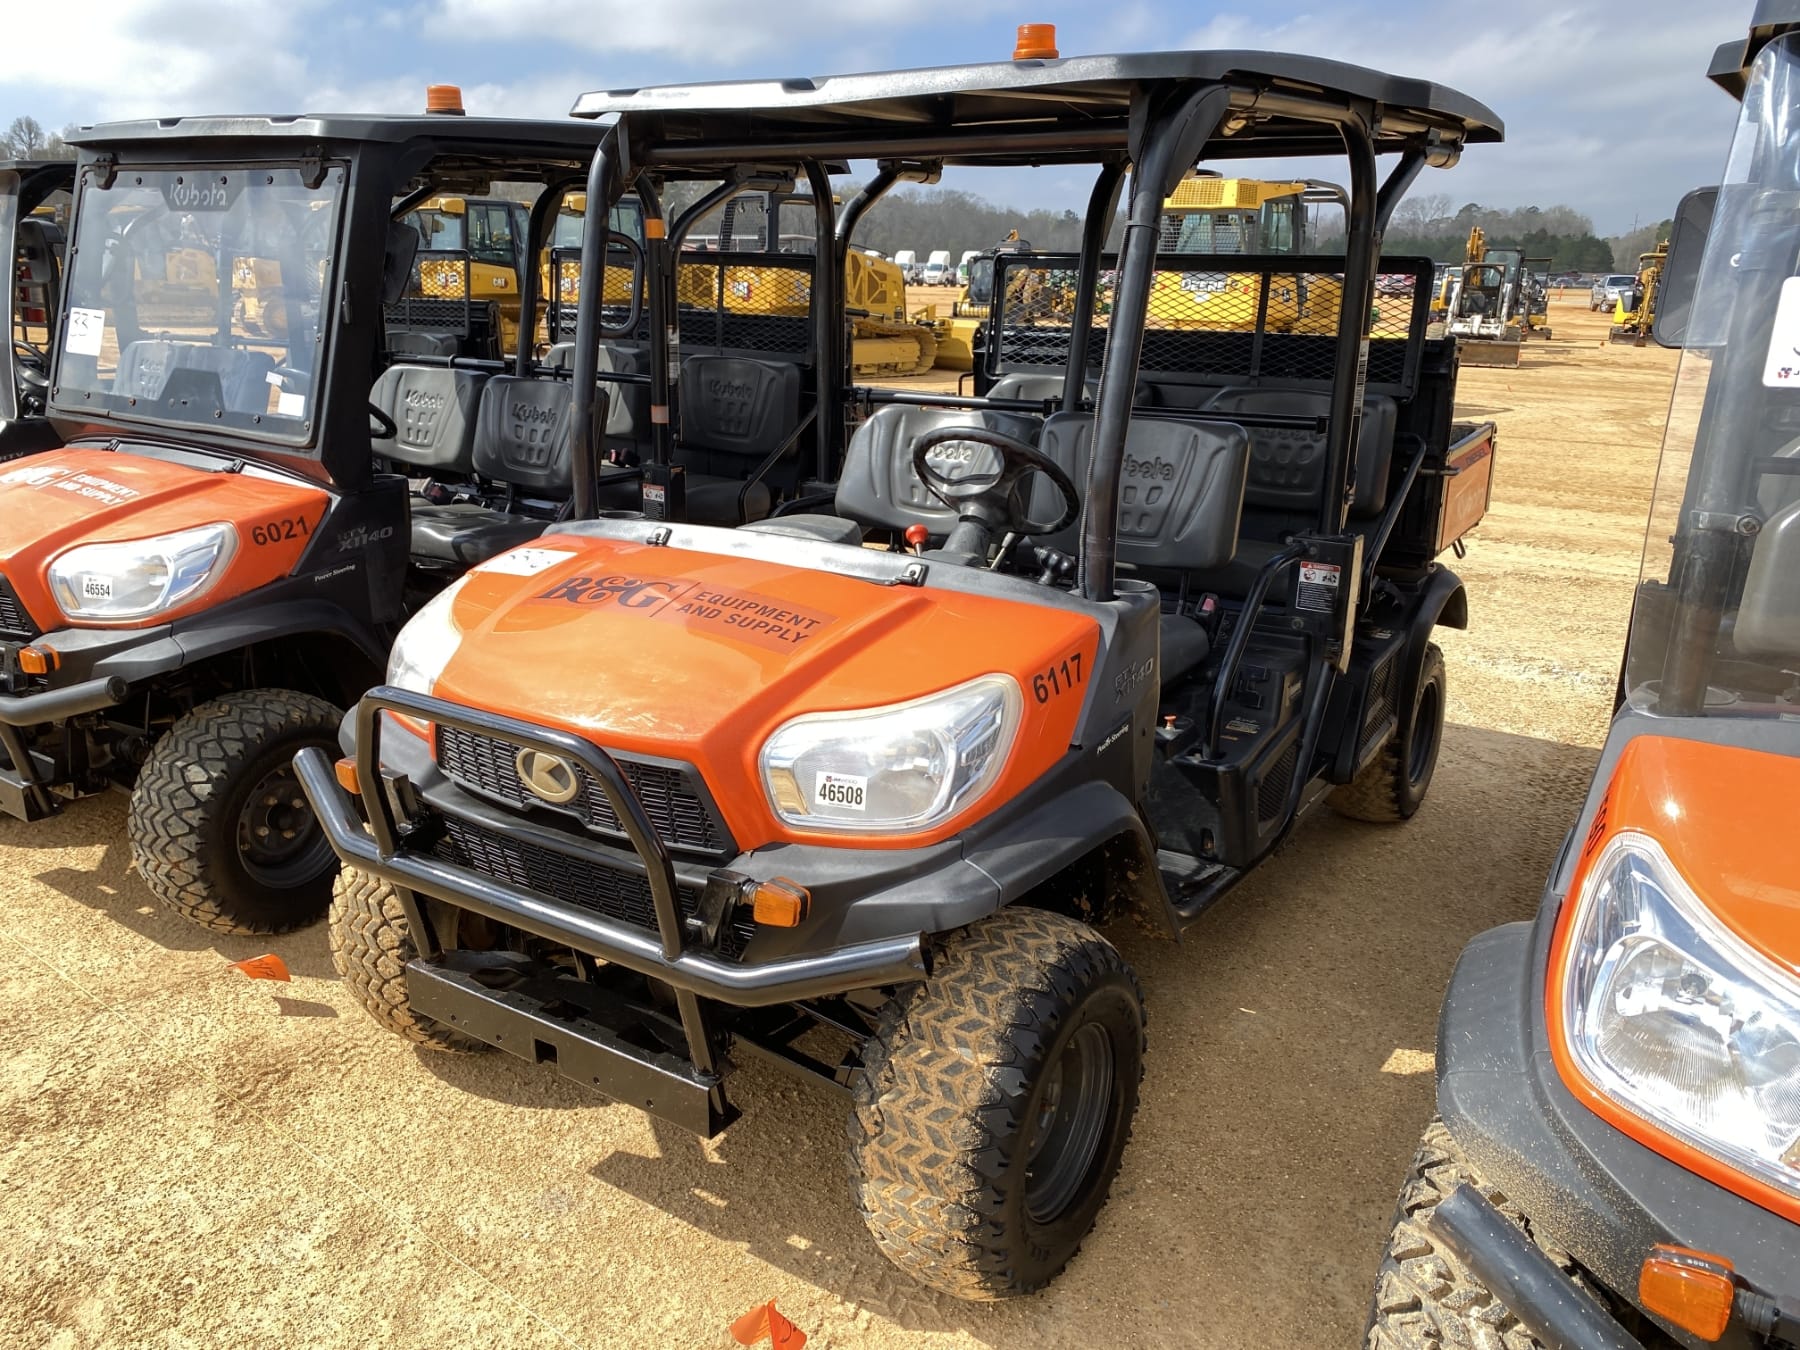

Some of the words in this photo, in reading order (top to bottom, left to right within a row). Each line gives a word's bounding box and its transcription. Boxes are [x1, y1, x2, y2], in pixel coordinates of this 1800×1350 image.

[168, 182, 227, 207] Kubota
[493, 278, 506, 288] CAT
[251, 515, 310, 547] 6021
[85, 583, 111, 597] 46554
[534, 575, 677, 609] B&G
[680, 601, 722, 620] AND
[723, 613, 809, 645] SUPPLY
[694, 591, 821, 631] EQUIPMENT
[1032, 652, 1082, 704] 6117
[819, 783, 863, 805] 46508
